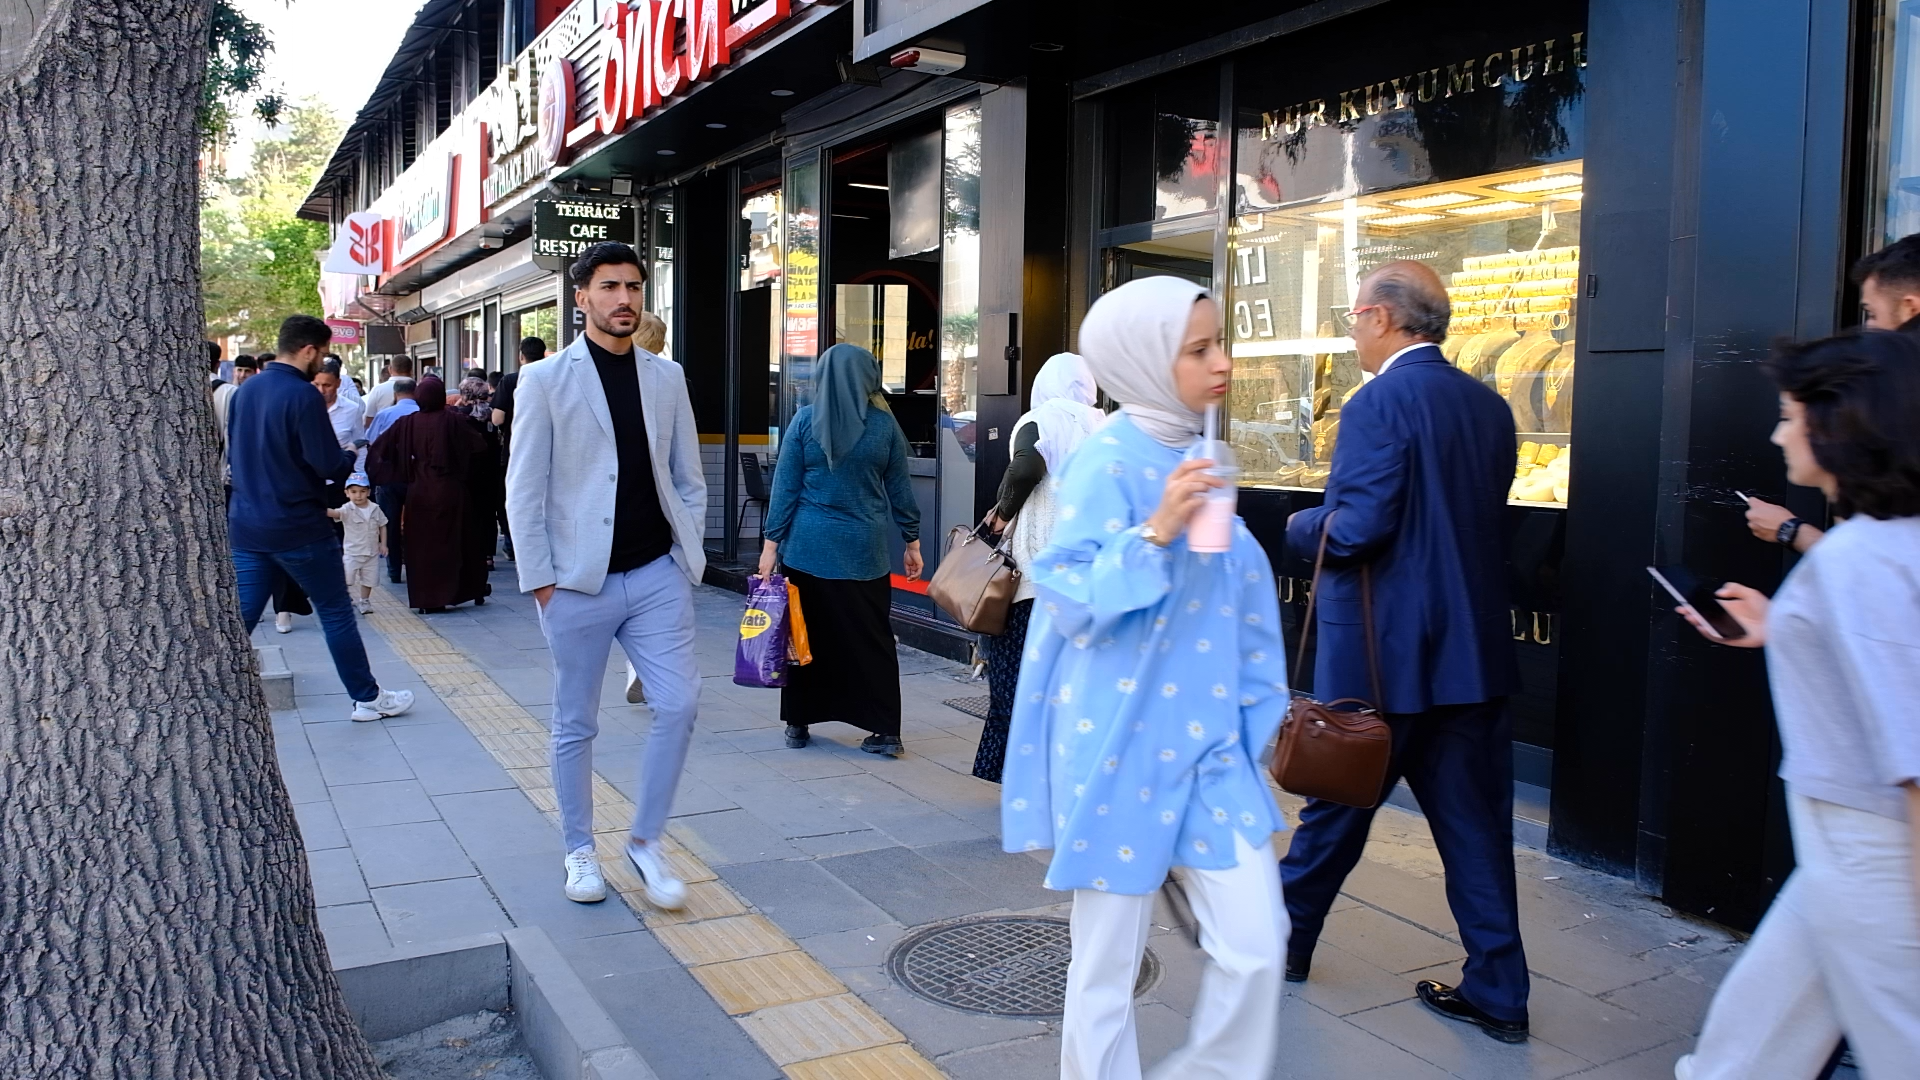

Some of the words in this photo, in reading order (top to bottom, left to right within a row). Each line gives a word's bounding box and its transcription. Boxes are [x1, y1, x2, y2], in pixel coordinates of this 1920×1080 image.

[1260, 99, 1328, 142] NUR
[555, 203, 621, 220] TERRACE
[569, 223, 608, 239] CAFE
